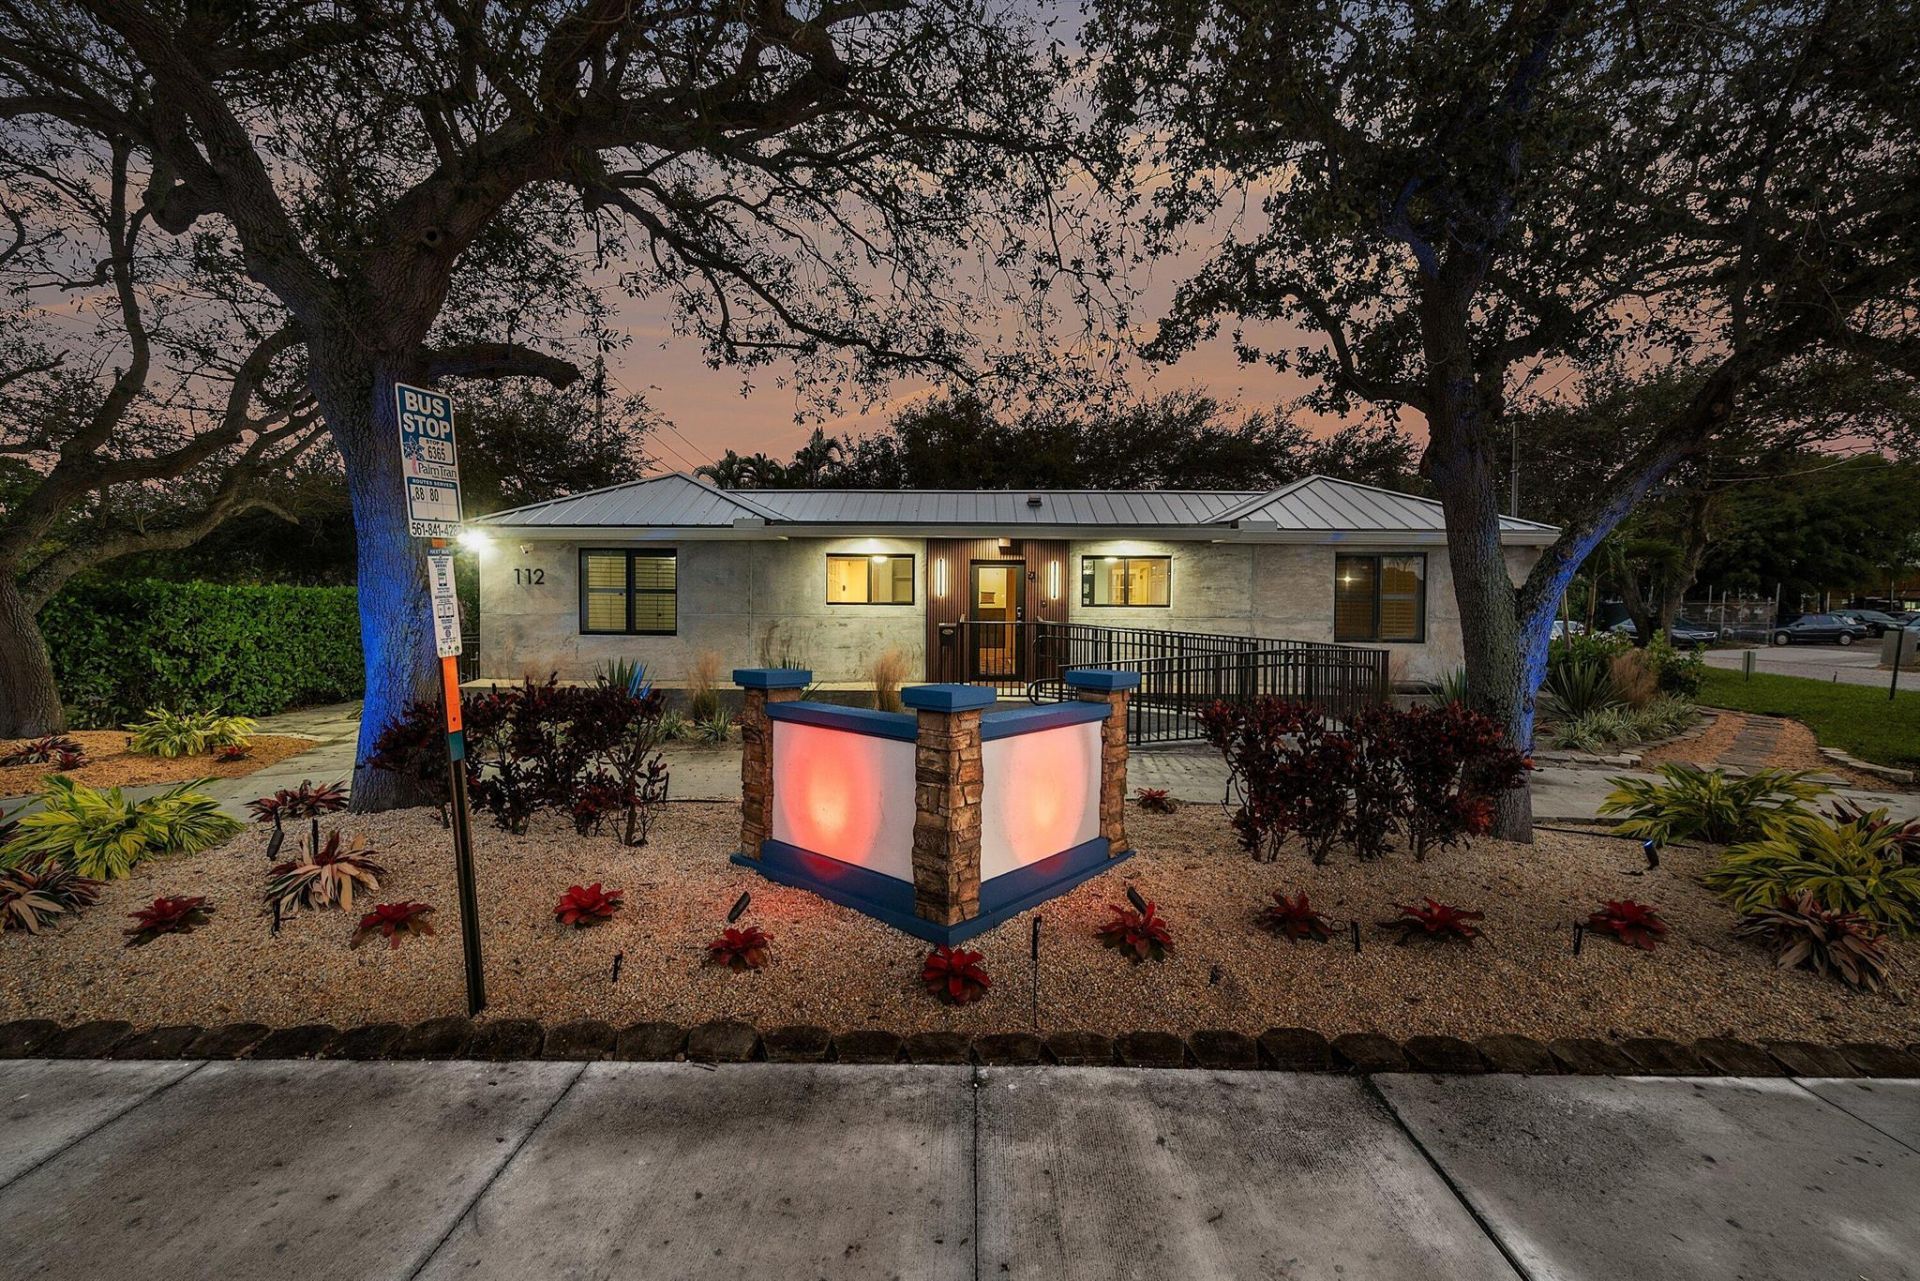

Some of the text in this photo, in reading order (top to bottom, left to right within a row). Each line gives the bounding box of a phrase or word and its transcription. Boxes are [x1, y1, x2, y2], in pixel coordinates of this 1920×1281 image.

[404, 390, 445, 418] BUS
[403, 412, 450, 438] STOP
[427, 445, 446, 461] 6365
[415, 487, 439, 502] 88 80
[514, 568, 545, 585] 112
